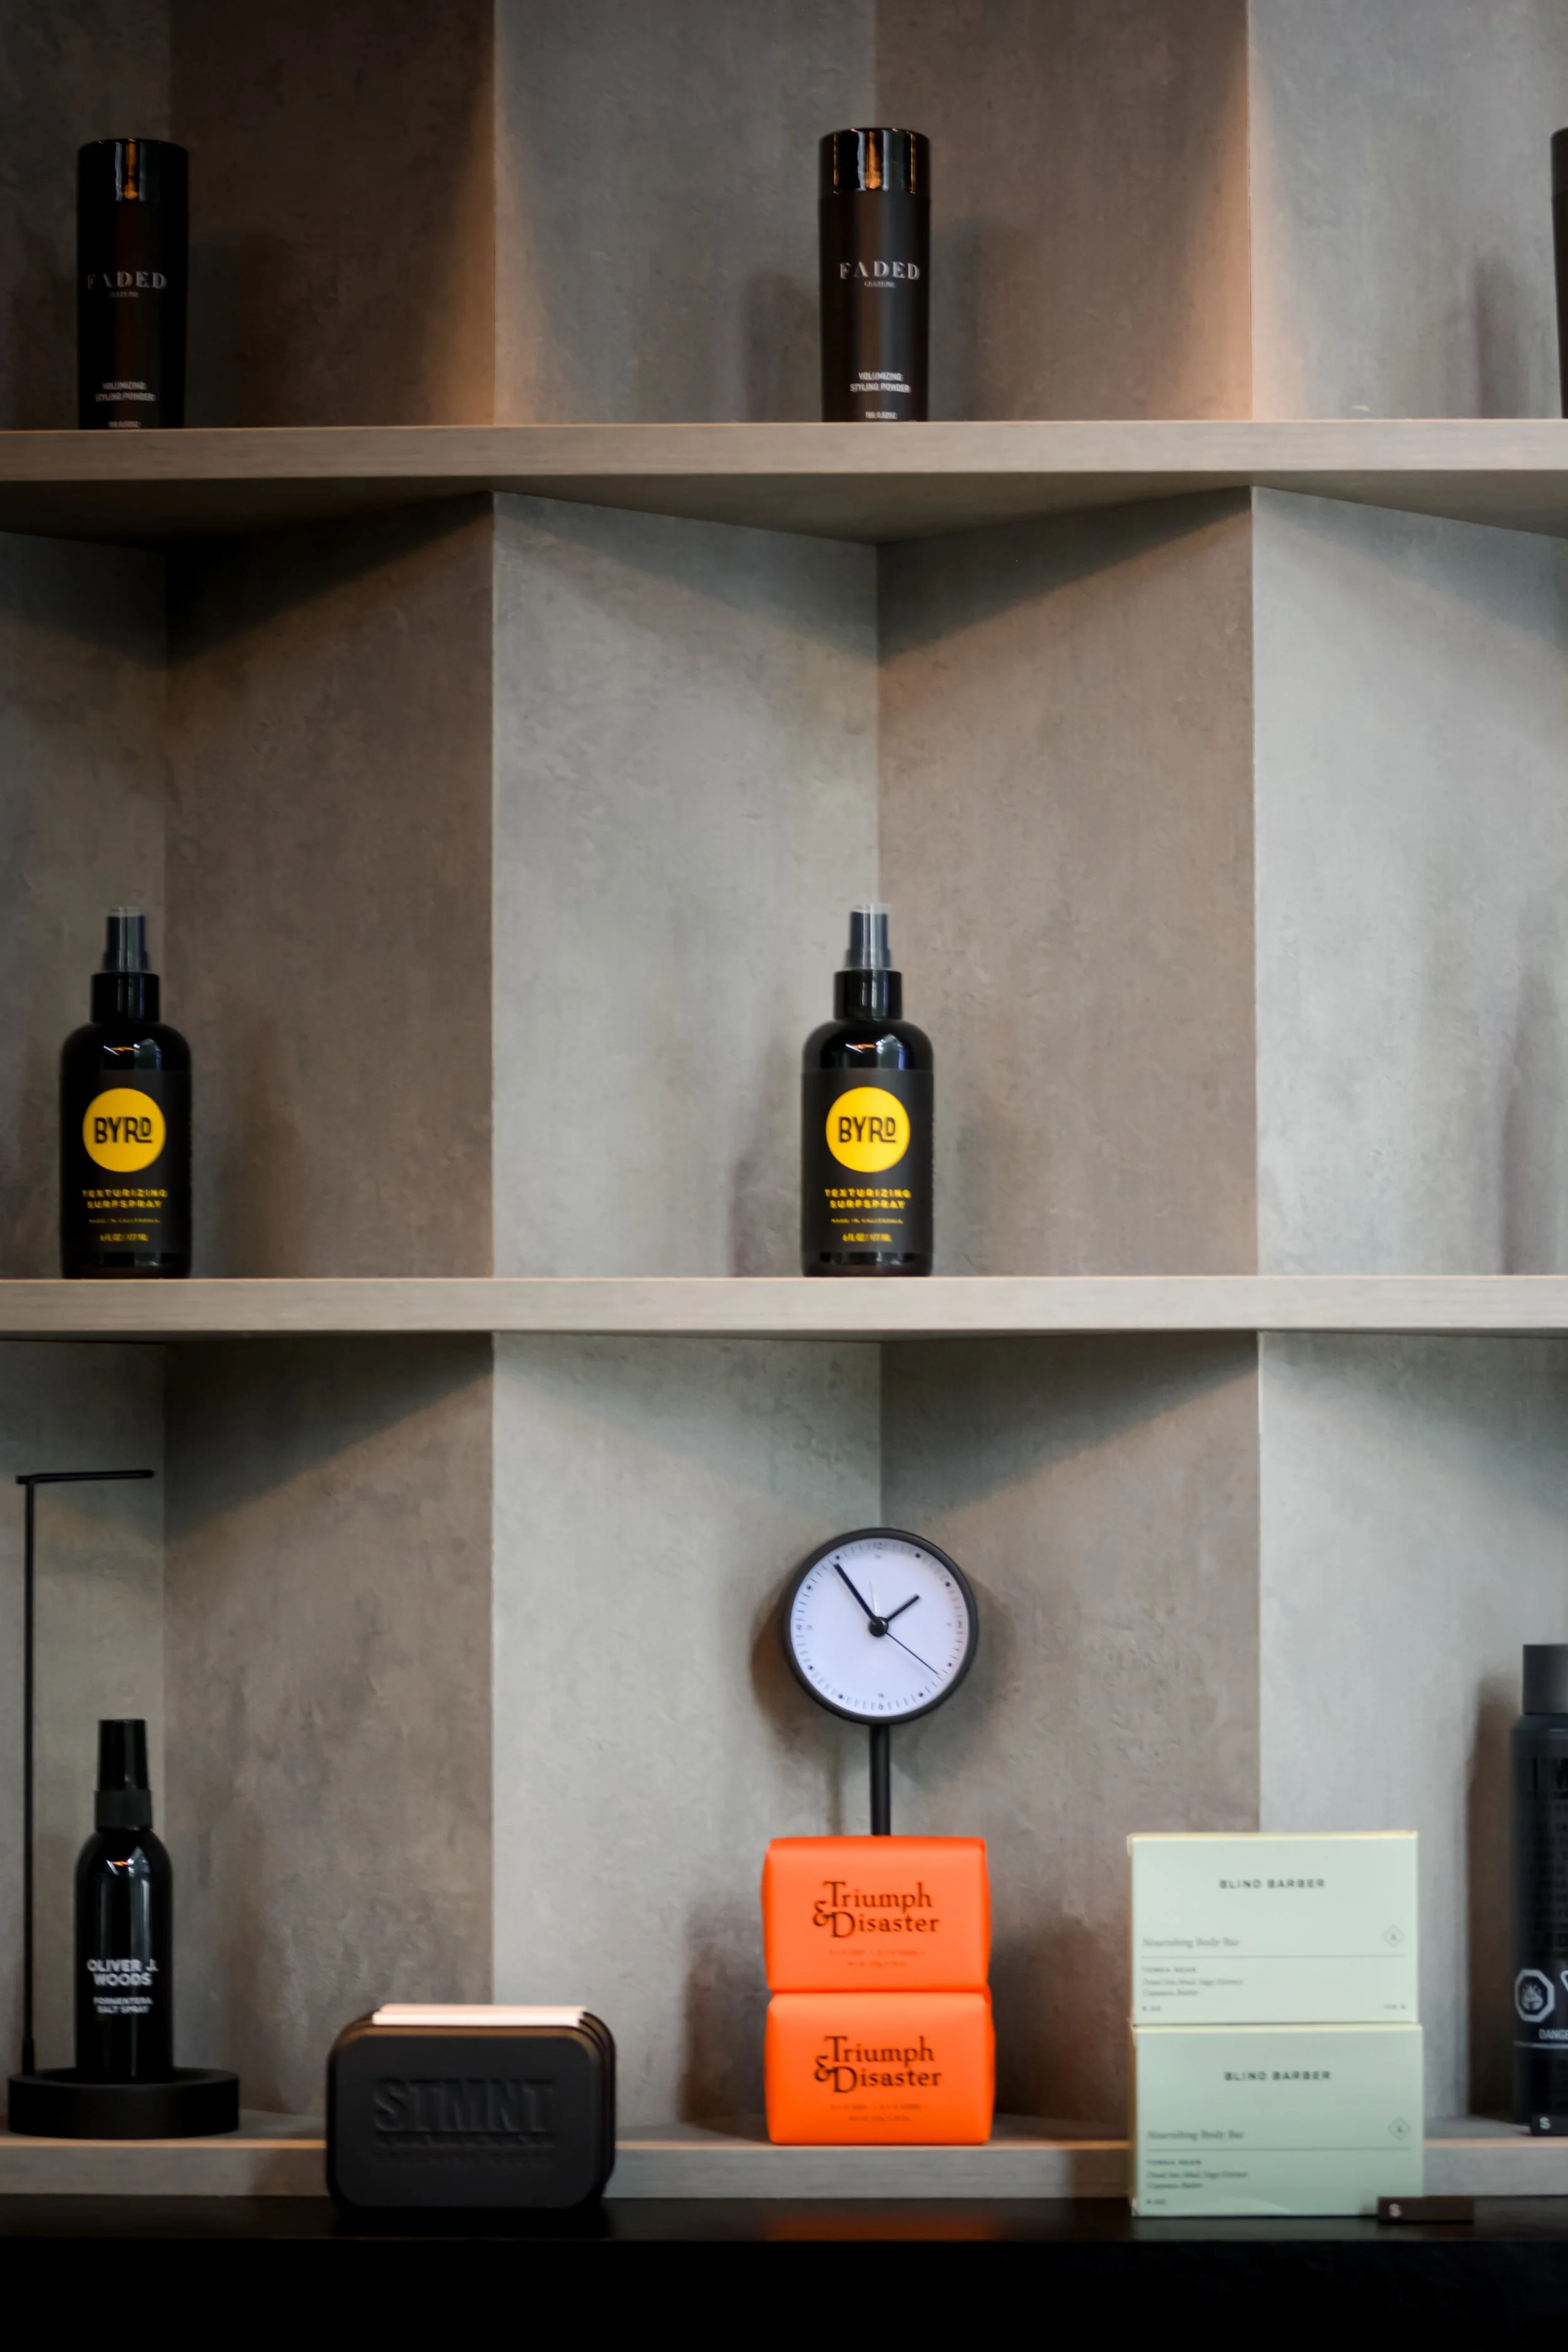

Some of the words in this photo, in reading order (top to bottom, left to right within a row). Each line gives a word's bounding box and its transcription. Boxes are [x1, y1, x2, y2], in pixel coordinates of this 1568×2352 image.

[839, 261, 921, 280] FADED
[87, 271, 167, 289] FADED
[858, 371, 904, 381] VOLUMIZING
[850, 382, 879, 392] STYLING
[881, 382, 911, 393] POWDER
[95, 1116, 153, 1143] BYRD
[839, 1116, 896, 1143] BYRD
[82, 1188, 168, 1198] TEXTURIZING
[824, 1188, 911, 1199] TEXTURIZING
[87, 1199, 162, 1209] SURFSPRAY
[829, 1199, 906, 1209] SURFSPRAY
[1219, 1878, 1262, 1889] BLIND
[1267, 1878, 1325, 1888] BARBER
[822, 1880, 933, 1913] Triumph
[87, 1959, 142, 1972] OLIVER
[93, 1972, 152, 1986] WOODS
[824, 2035, 935, 2068] Triumph
[1224, 2071, 1267, 2081] BLIND
[1271, 2070, 1331, 2080] BARBER
[373, 2077, 556, 2132] STMNT
